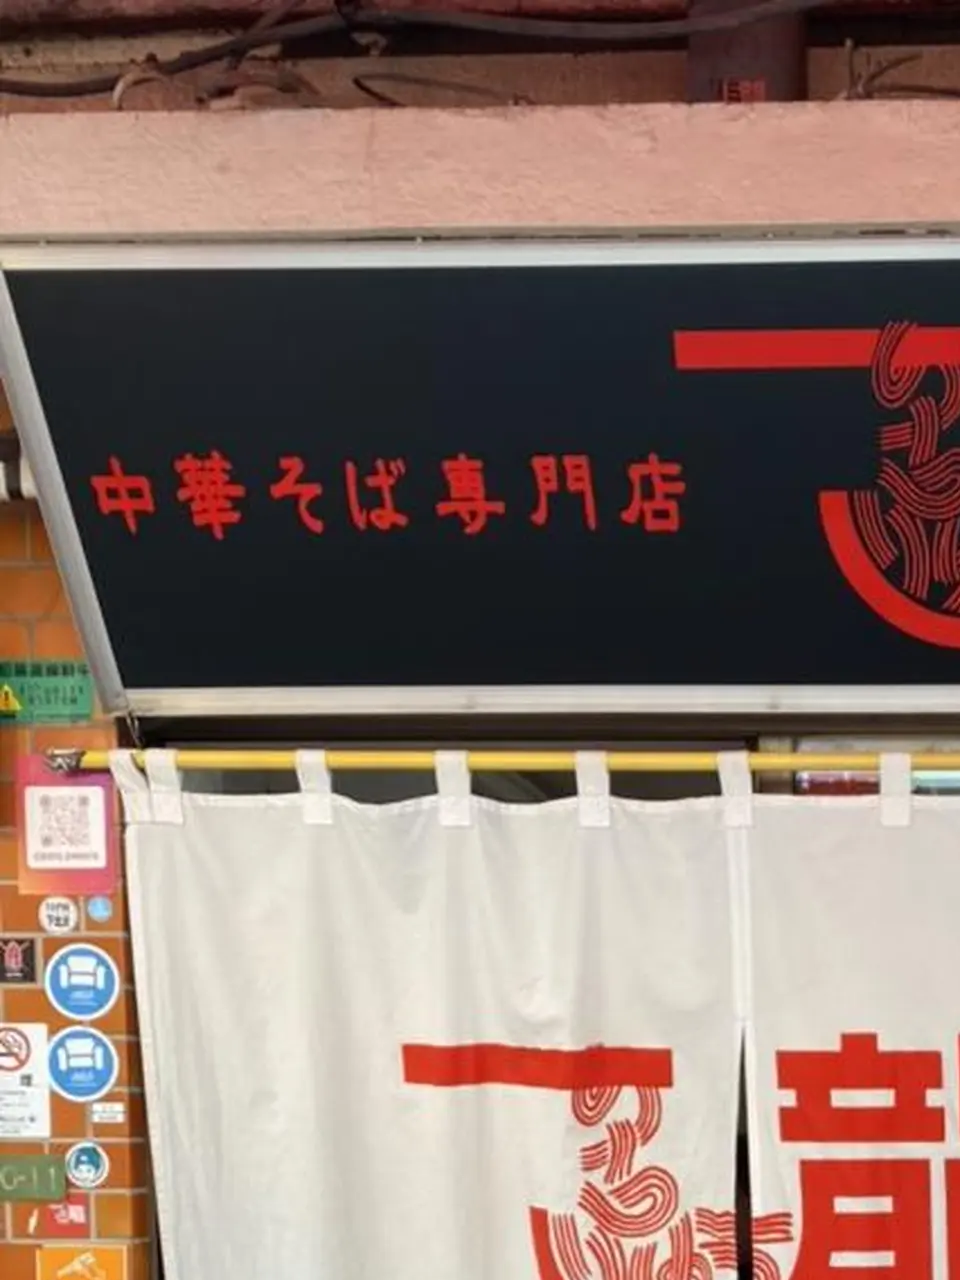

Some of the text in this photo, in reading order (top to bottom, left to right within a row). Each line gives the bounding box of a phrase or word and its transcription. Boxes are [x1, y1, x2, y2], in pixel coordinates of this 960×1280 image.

[91, 450, 687, 541] 中華そば専門店
